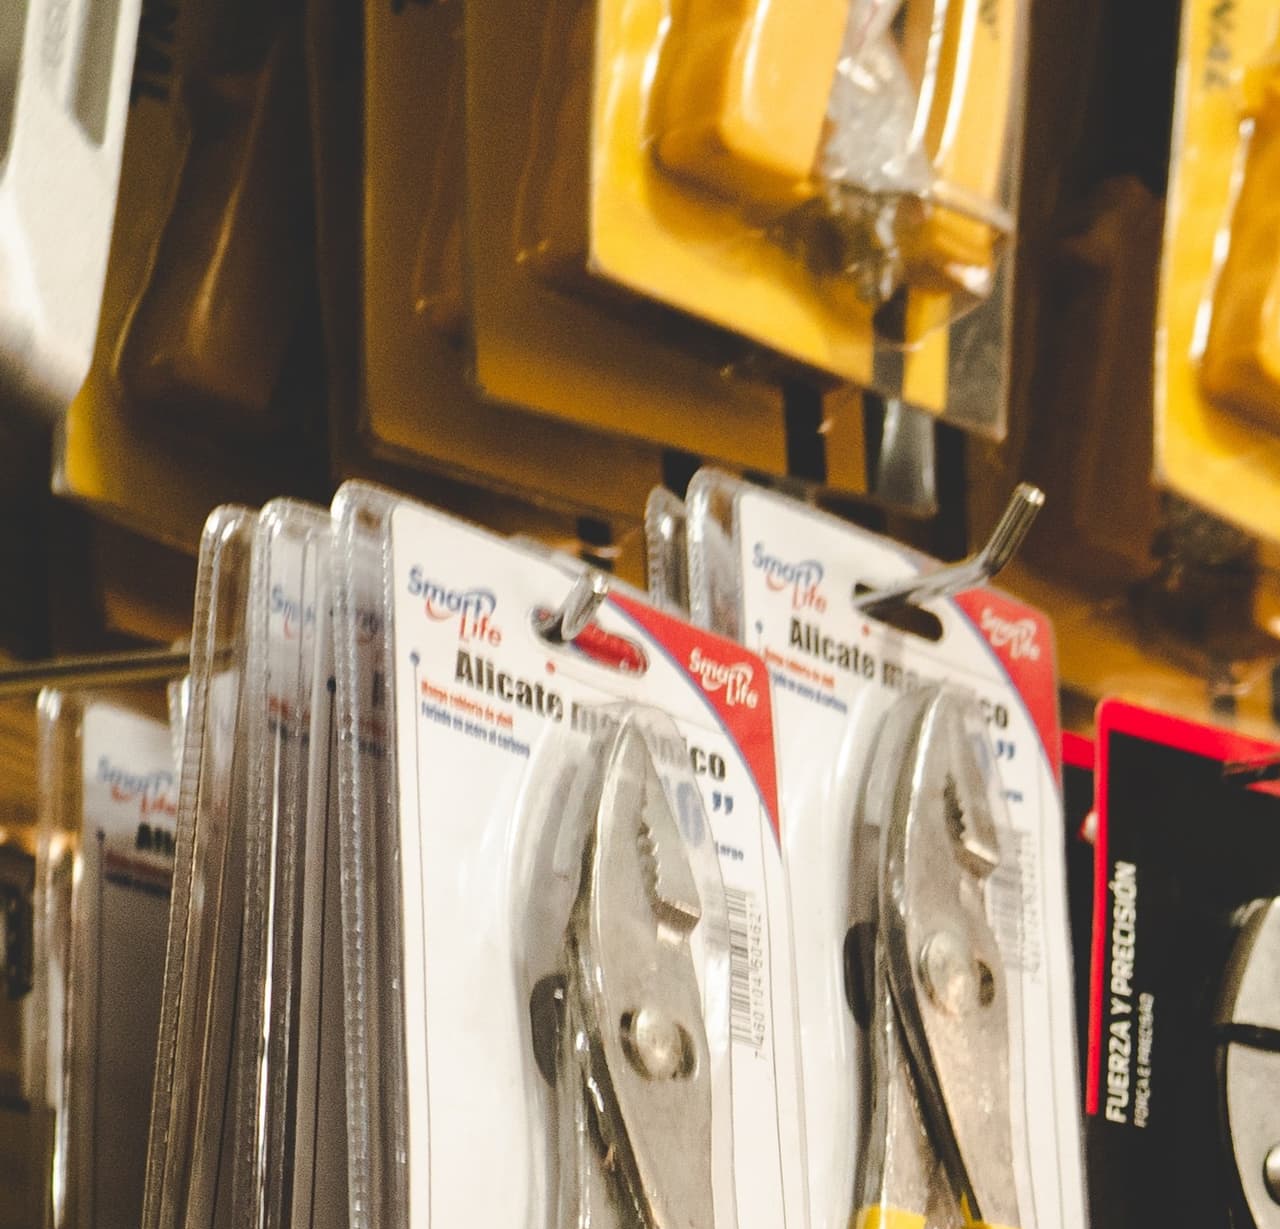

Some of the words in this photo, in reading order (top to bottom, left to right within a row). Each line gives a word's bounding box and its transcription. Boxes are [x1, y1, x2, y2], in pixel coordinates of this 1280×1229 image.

[454, 647, 564, 723] Alicate
[788, 615, 875, 680] Alicate
[1108, 860, 1138, 997] PRECISIÓN
[1110, 996, 1133, 1016] Y
[1105, 1019, 1133, 1124] FUERZA
